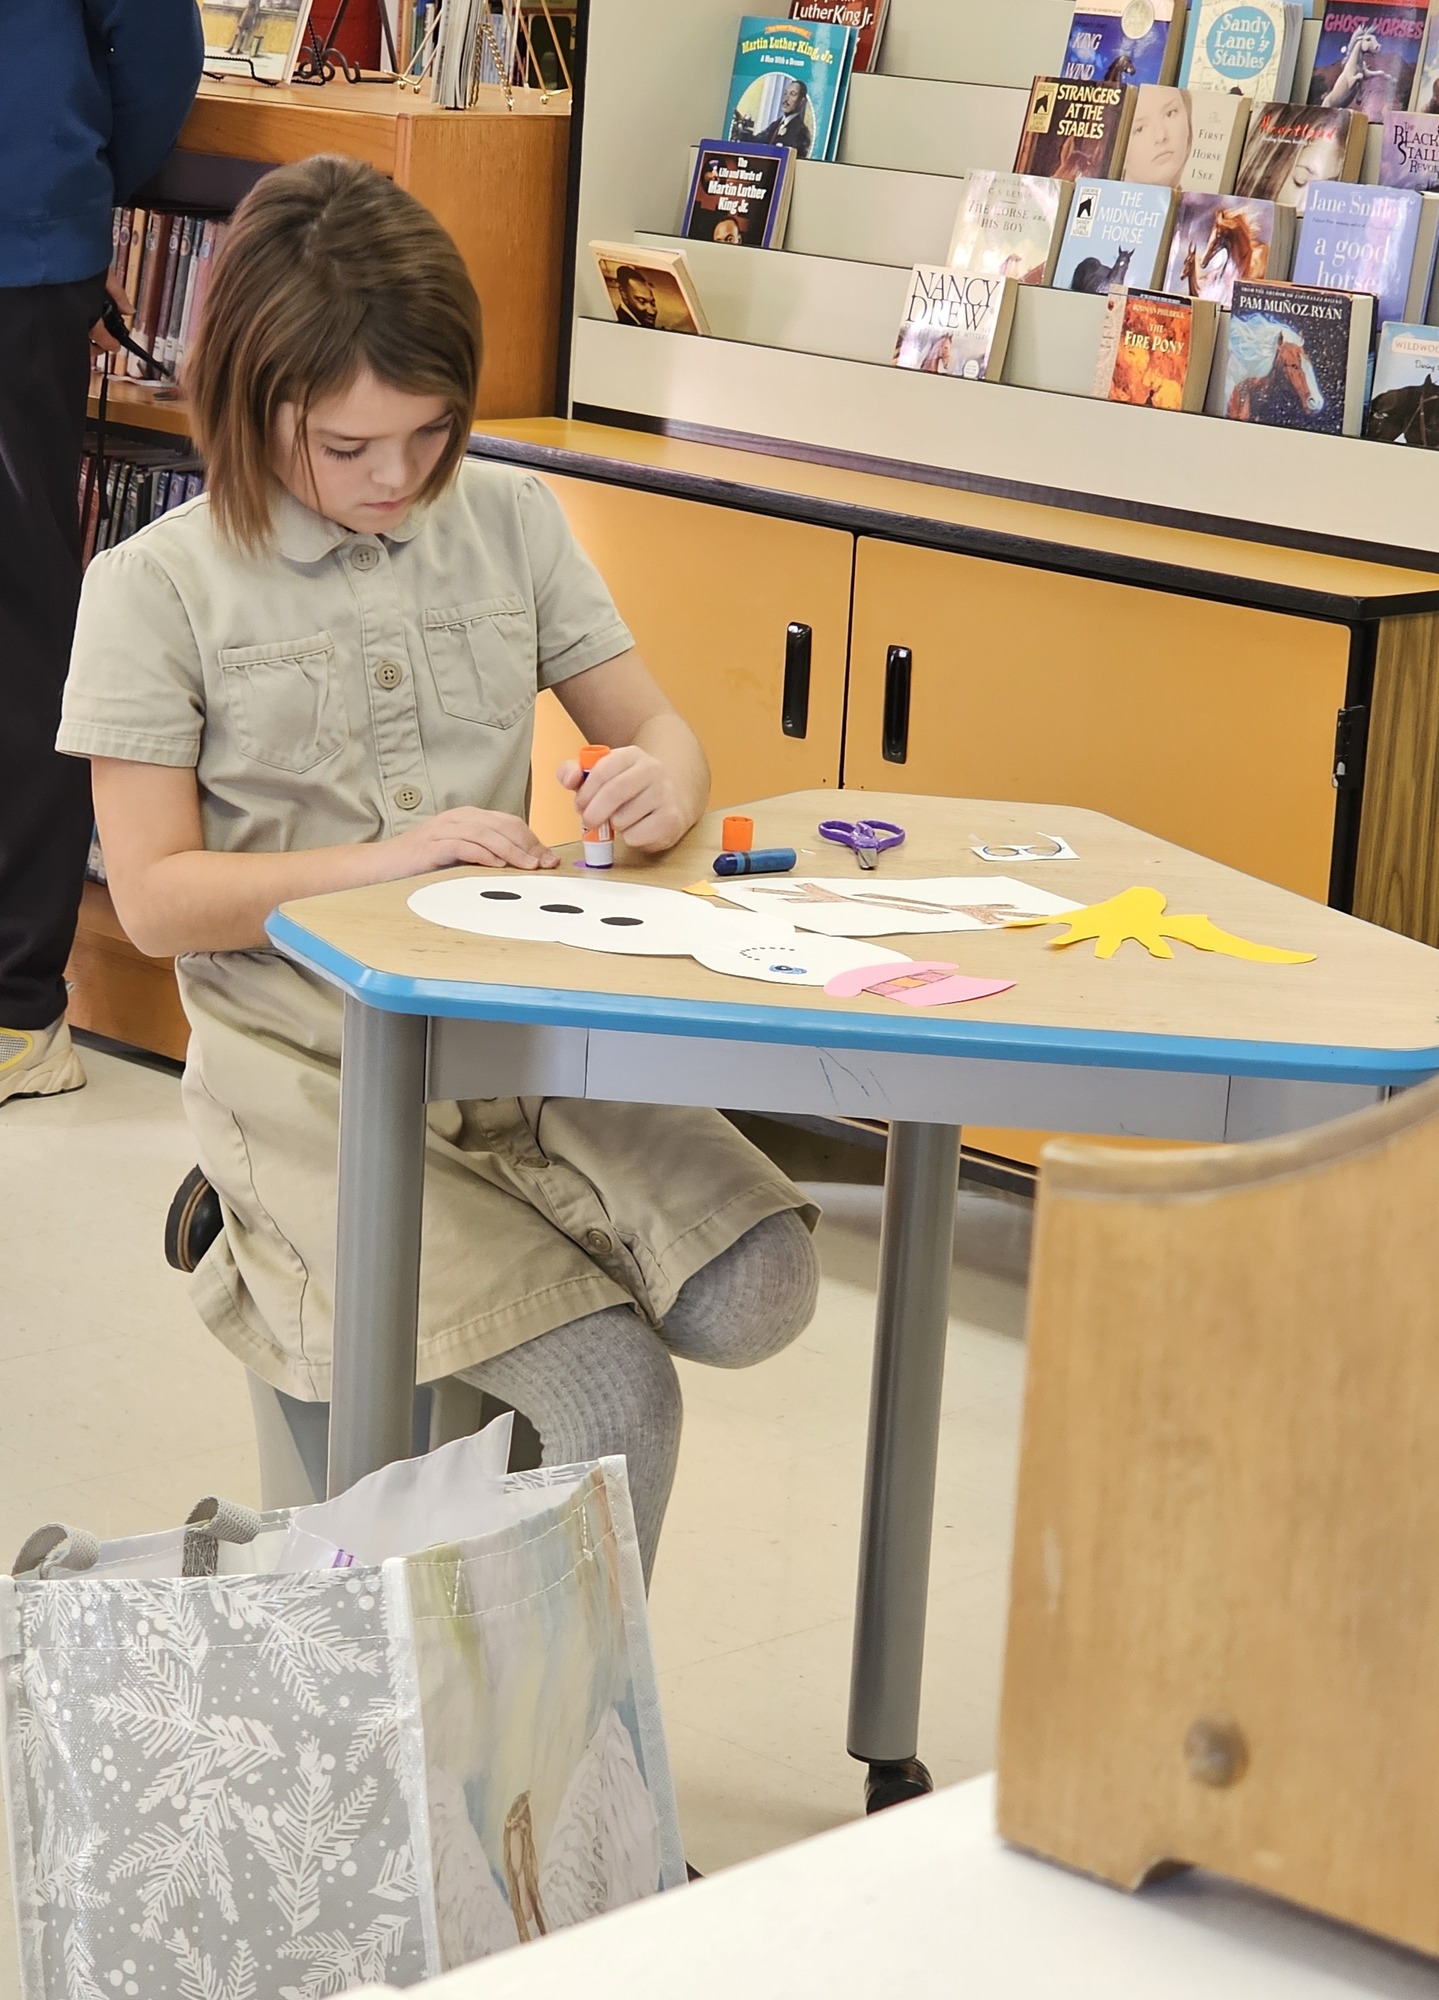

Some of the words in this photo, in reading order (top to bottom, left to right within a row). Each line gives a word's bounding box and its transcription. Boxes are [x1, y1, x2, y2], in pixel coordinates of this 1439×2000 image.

[792, 2, 833, 21] Luther
[832, 5, 861, 26] King
[859, 7, 874, 29] Jr.
[1220, 13, 1271, 39] Sandy
[1324, 13, 1369, 32] GHOST
[1371, 17, 1424, 40] HORSES
[742, 37, 768, 54] Martin
[769, 36, 797, 52] Luther
[1072, 32, 1103, 51] KING
[1214, 30, 1255, 50] Lane
[1212, 48, 1265, 70] Stables
[1065, 62, 1095, 81] WIND
[1057, 84, 1121, 105] STRANGERS
[1065, 103, 1082, 119] AT
[1082, 104, 1104, 121] THE
[1057, 120, 1104, 139] STABLES
[1198, 129, 1225, 141] FIRST
[1260, 115, 1336, 140] Heartland
[1394, 125, 1439, 147] BLACK
[1192, 148, 1222, 161] HORSE
[707, 180, 737, 197] Martin
[737, 183, 767, 200] Luther
[1120, 190, 1144, 208] THE
[718, 196, 739, 215] King
[738, 199, 749, 213] Jr.
[968, 200, 990, 215] THE
[1310, 189, 1346, 213] Jane
[981, 218, 999, 229] HIS
[1003, 221, 1025, 233] BOY
[1097, 206, 1162, 228] MIDNIGHT
[1101, 224, 1145, 244] HORSE
[1314, 237, 1327, 256] a
[1332, 234, 1391, 268] good
[1316, 260, 1376, 292] horse
[912, 270, 1000, 307] NANCY
[906, 295, 989, 331] DREW
[1240, 296, 1262, 310] PAM
[1264, 299, 1309, 316] MUÑOZ
[1311, 305, 1343, 320] RYAN
[1149, 323, 1164, 333] THE
[1124, 330, 1150, 349] FIRE
[1151, 335, 1185, 355] PONY
